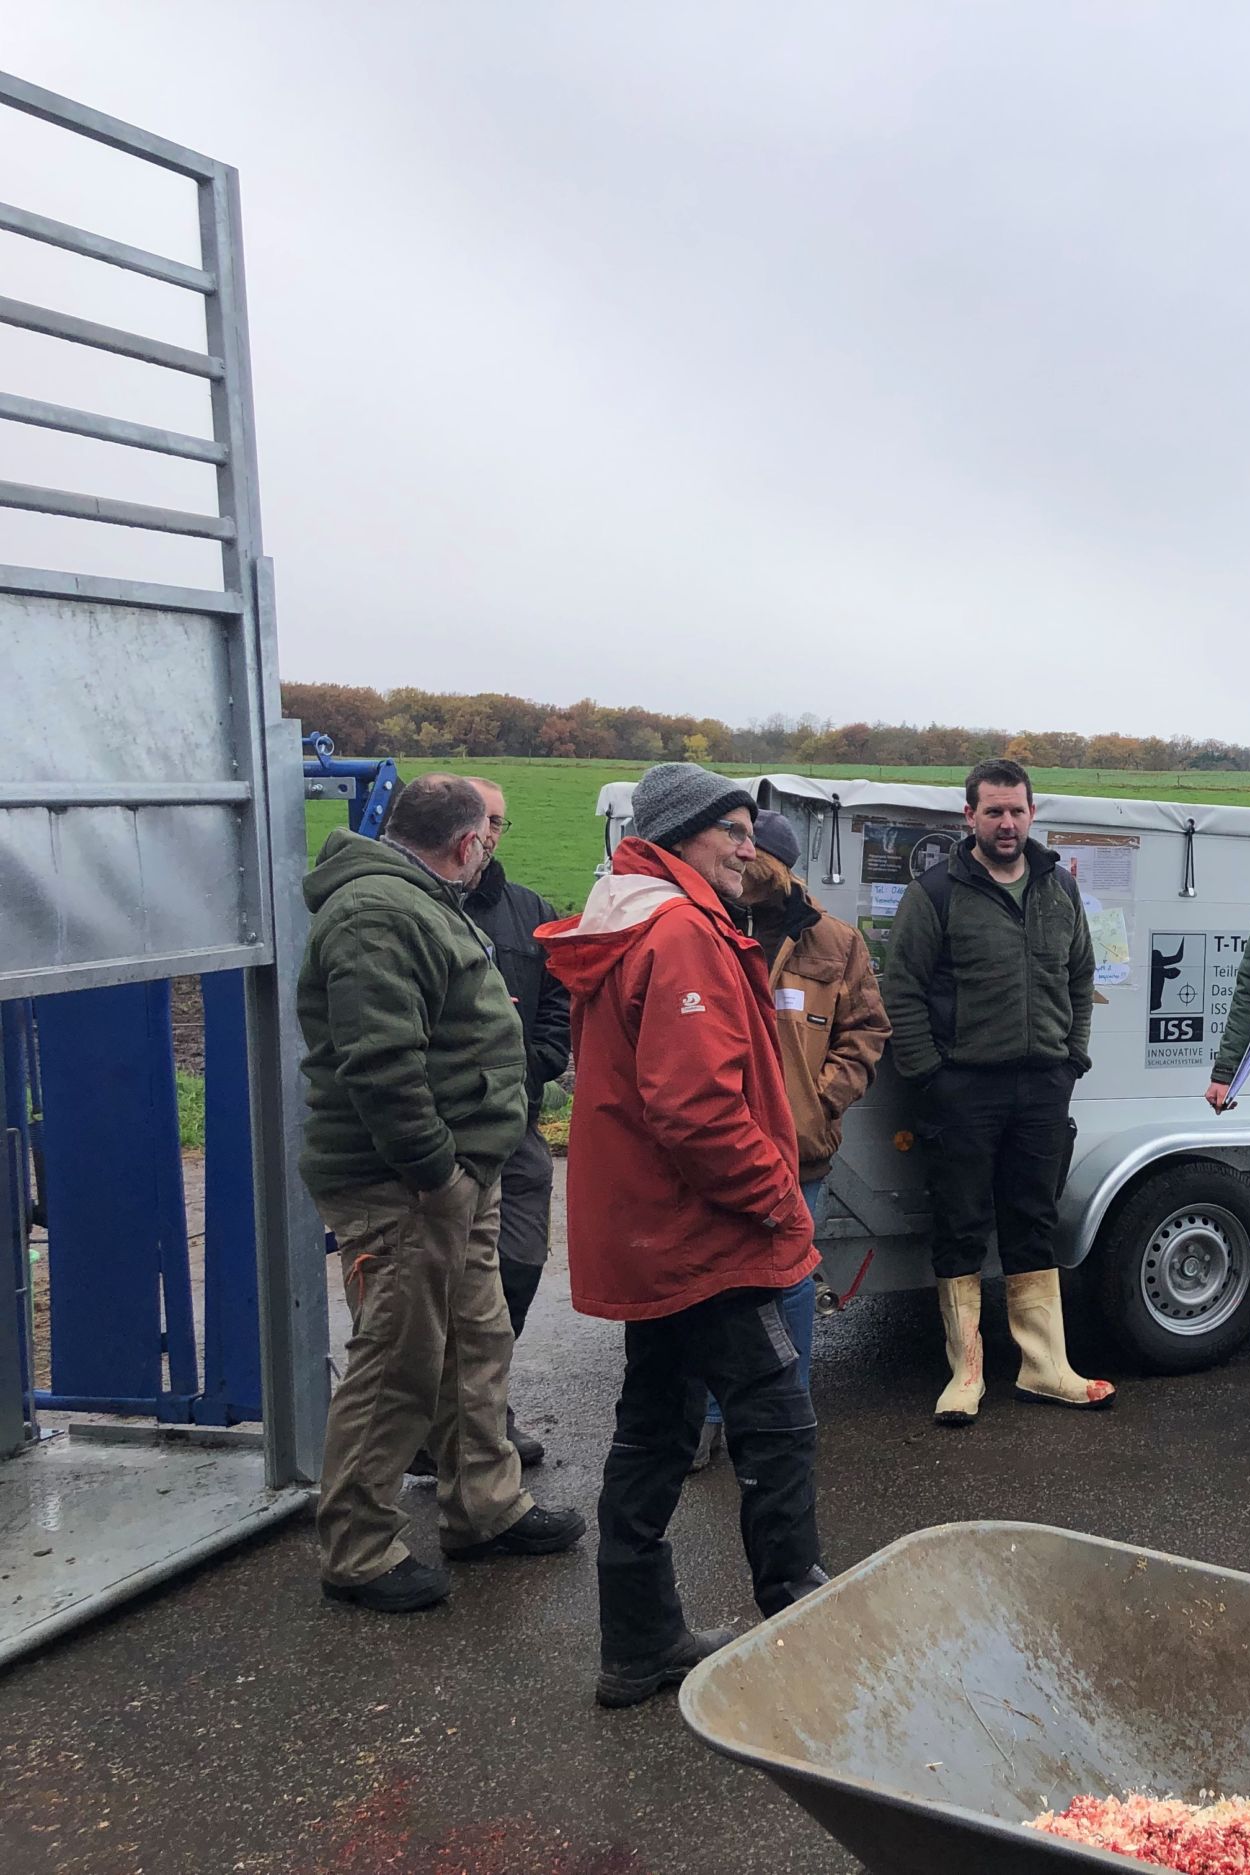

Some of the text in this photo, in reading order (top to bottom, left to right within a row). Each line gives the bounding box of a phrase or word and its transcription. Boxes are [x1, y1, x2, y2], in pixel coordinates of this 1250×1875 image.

[1211, 984, 1233, 997] Das
[1211, 1002, 1227, 1015] ISS
[1159, 1019, 1193, 1040] ISS
[1147, 1047, 1203, 1058] INNOVATIVE
[1147, 1058, 1203, 1066] SCHLACHTSYSTEME
